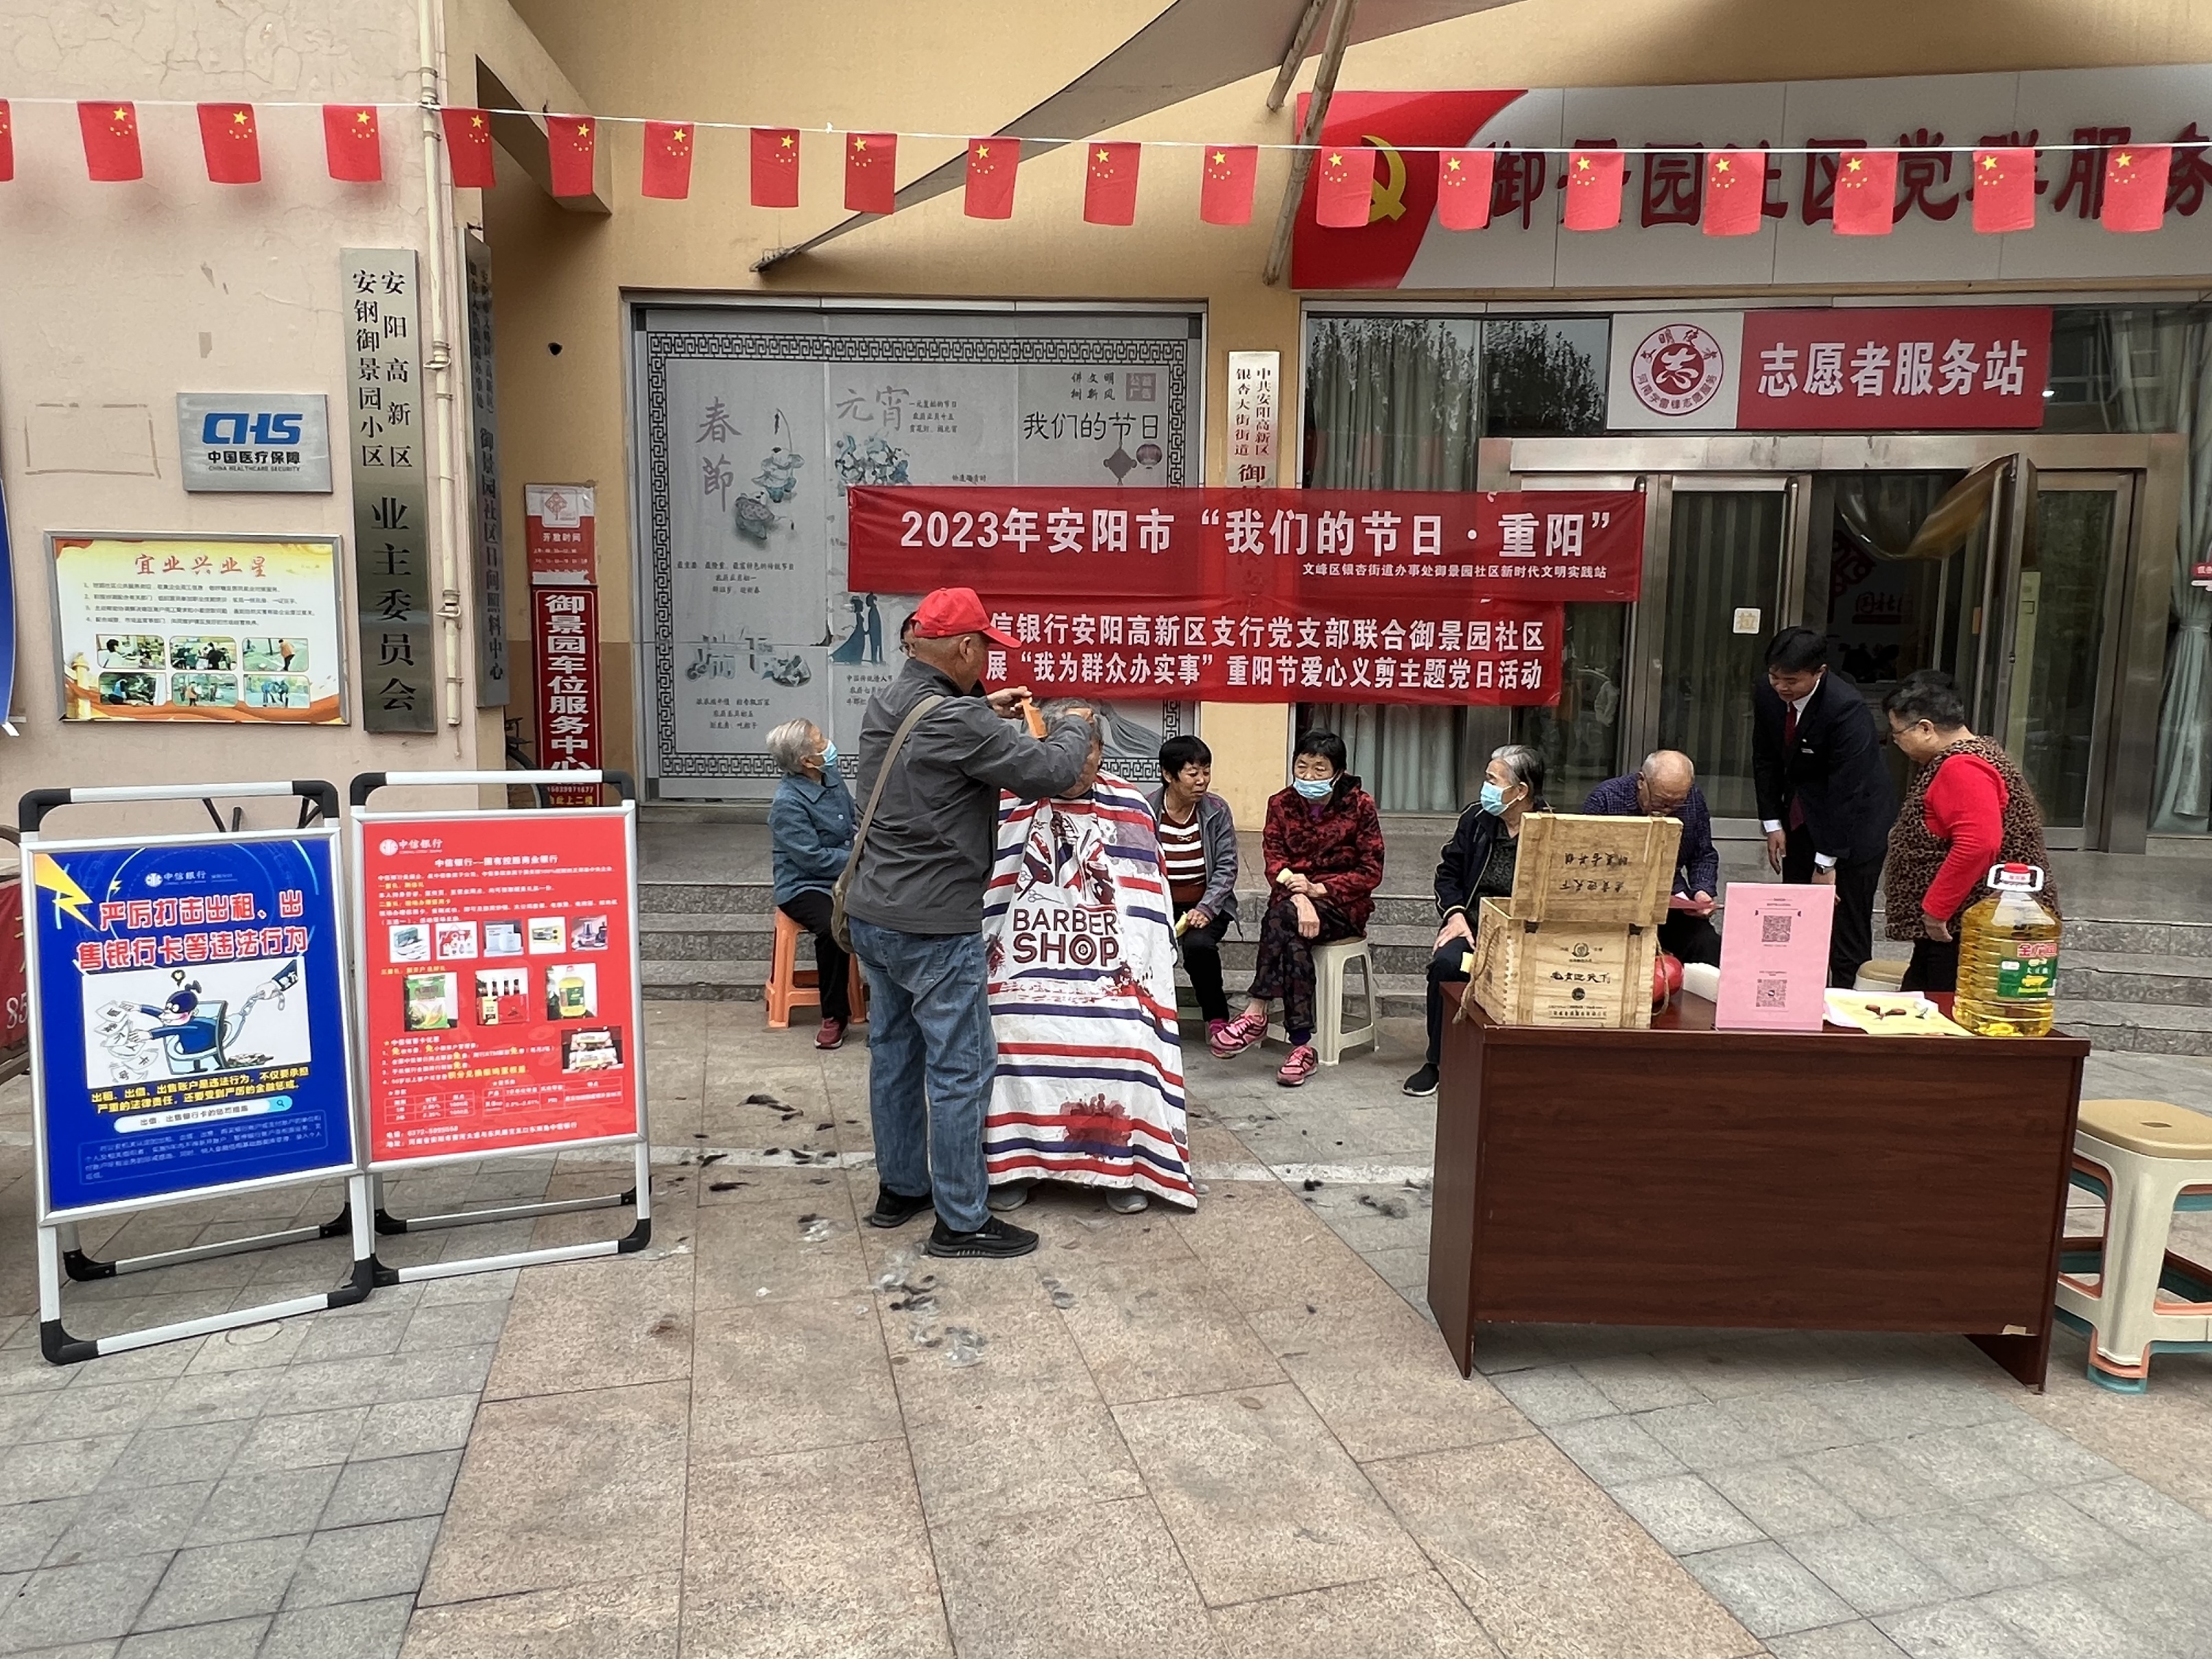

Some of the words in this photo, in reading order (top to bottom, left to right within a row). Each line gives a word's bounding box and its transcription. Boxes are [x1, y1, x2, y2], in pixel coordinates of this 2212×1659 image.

[353, 270, 385, 468] 安钢御景园小区
[381, 270, 413, 468] 安阳高新区
[1758, 338, 2028, 397] 志愿者服务站
[202, 413, 302, 444] CHS
[835, 385, 909, 431] 元宵
[1023, 411, 1159, 441] 我们的节日
[1235, 368, 1252, 457] 银杏大街街道
[1255, 368, 1271, 455] 中共安阳高新区
[208, 450, 300, 464] 中国医疗保障
[1239, 464, 1267, 487] 御
[1303, 562, 1607, 580] 文峰区银杏街道办事处御景园社区新时代文明实践站
[372, 497, 417, 713] 业主委员会
[99, 890, 303, 931] 严厉打击出租、出
[1012, 907, 1119, 935] BARBER
[76, 926, 309, 970] 售银行卡等违法行为
[1012, 931, 1120, 966] SHOP
